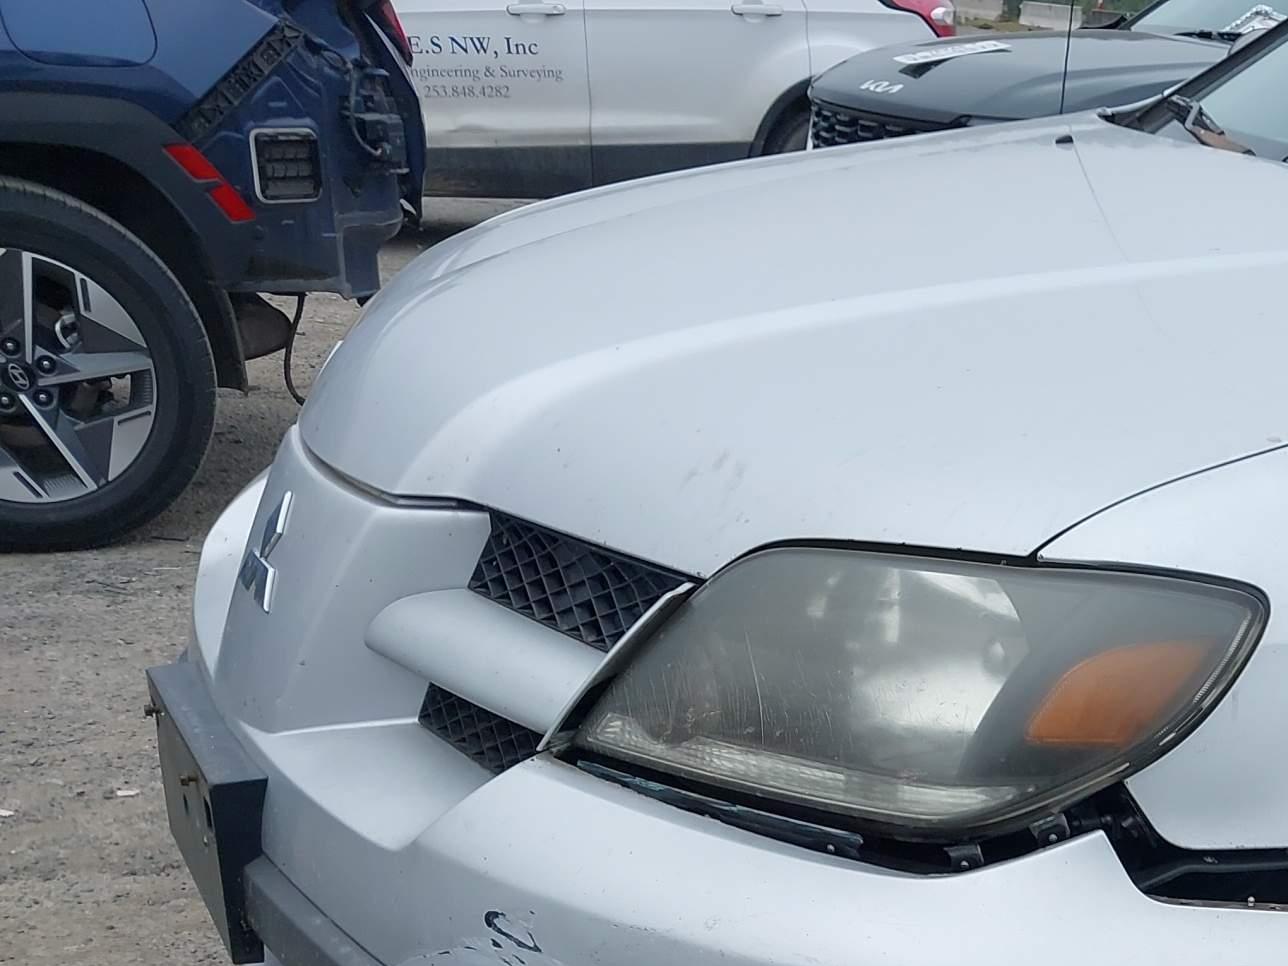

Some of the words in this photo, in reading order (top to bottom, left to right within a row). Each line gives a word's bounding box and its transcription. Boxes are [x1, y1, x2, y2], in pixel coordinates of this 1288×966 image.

[448, 36, 498, 59] NW,
[504, 36, 539, 55] Inc
[410, 64, 481, 81] ngineering
[484, 65, 496, 78] &
[500, 65, 563, 83] Surveying
[424, 85, 510, 98] 253.848.4282
